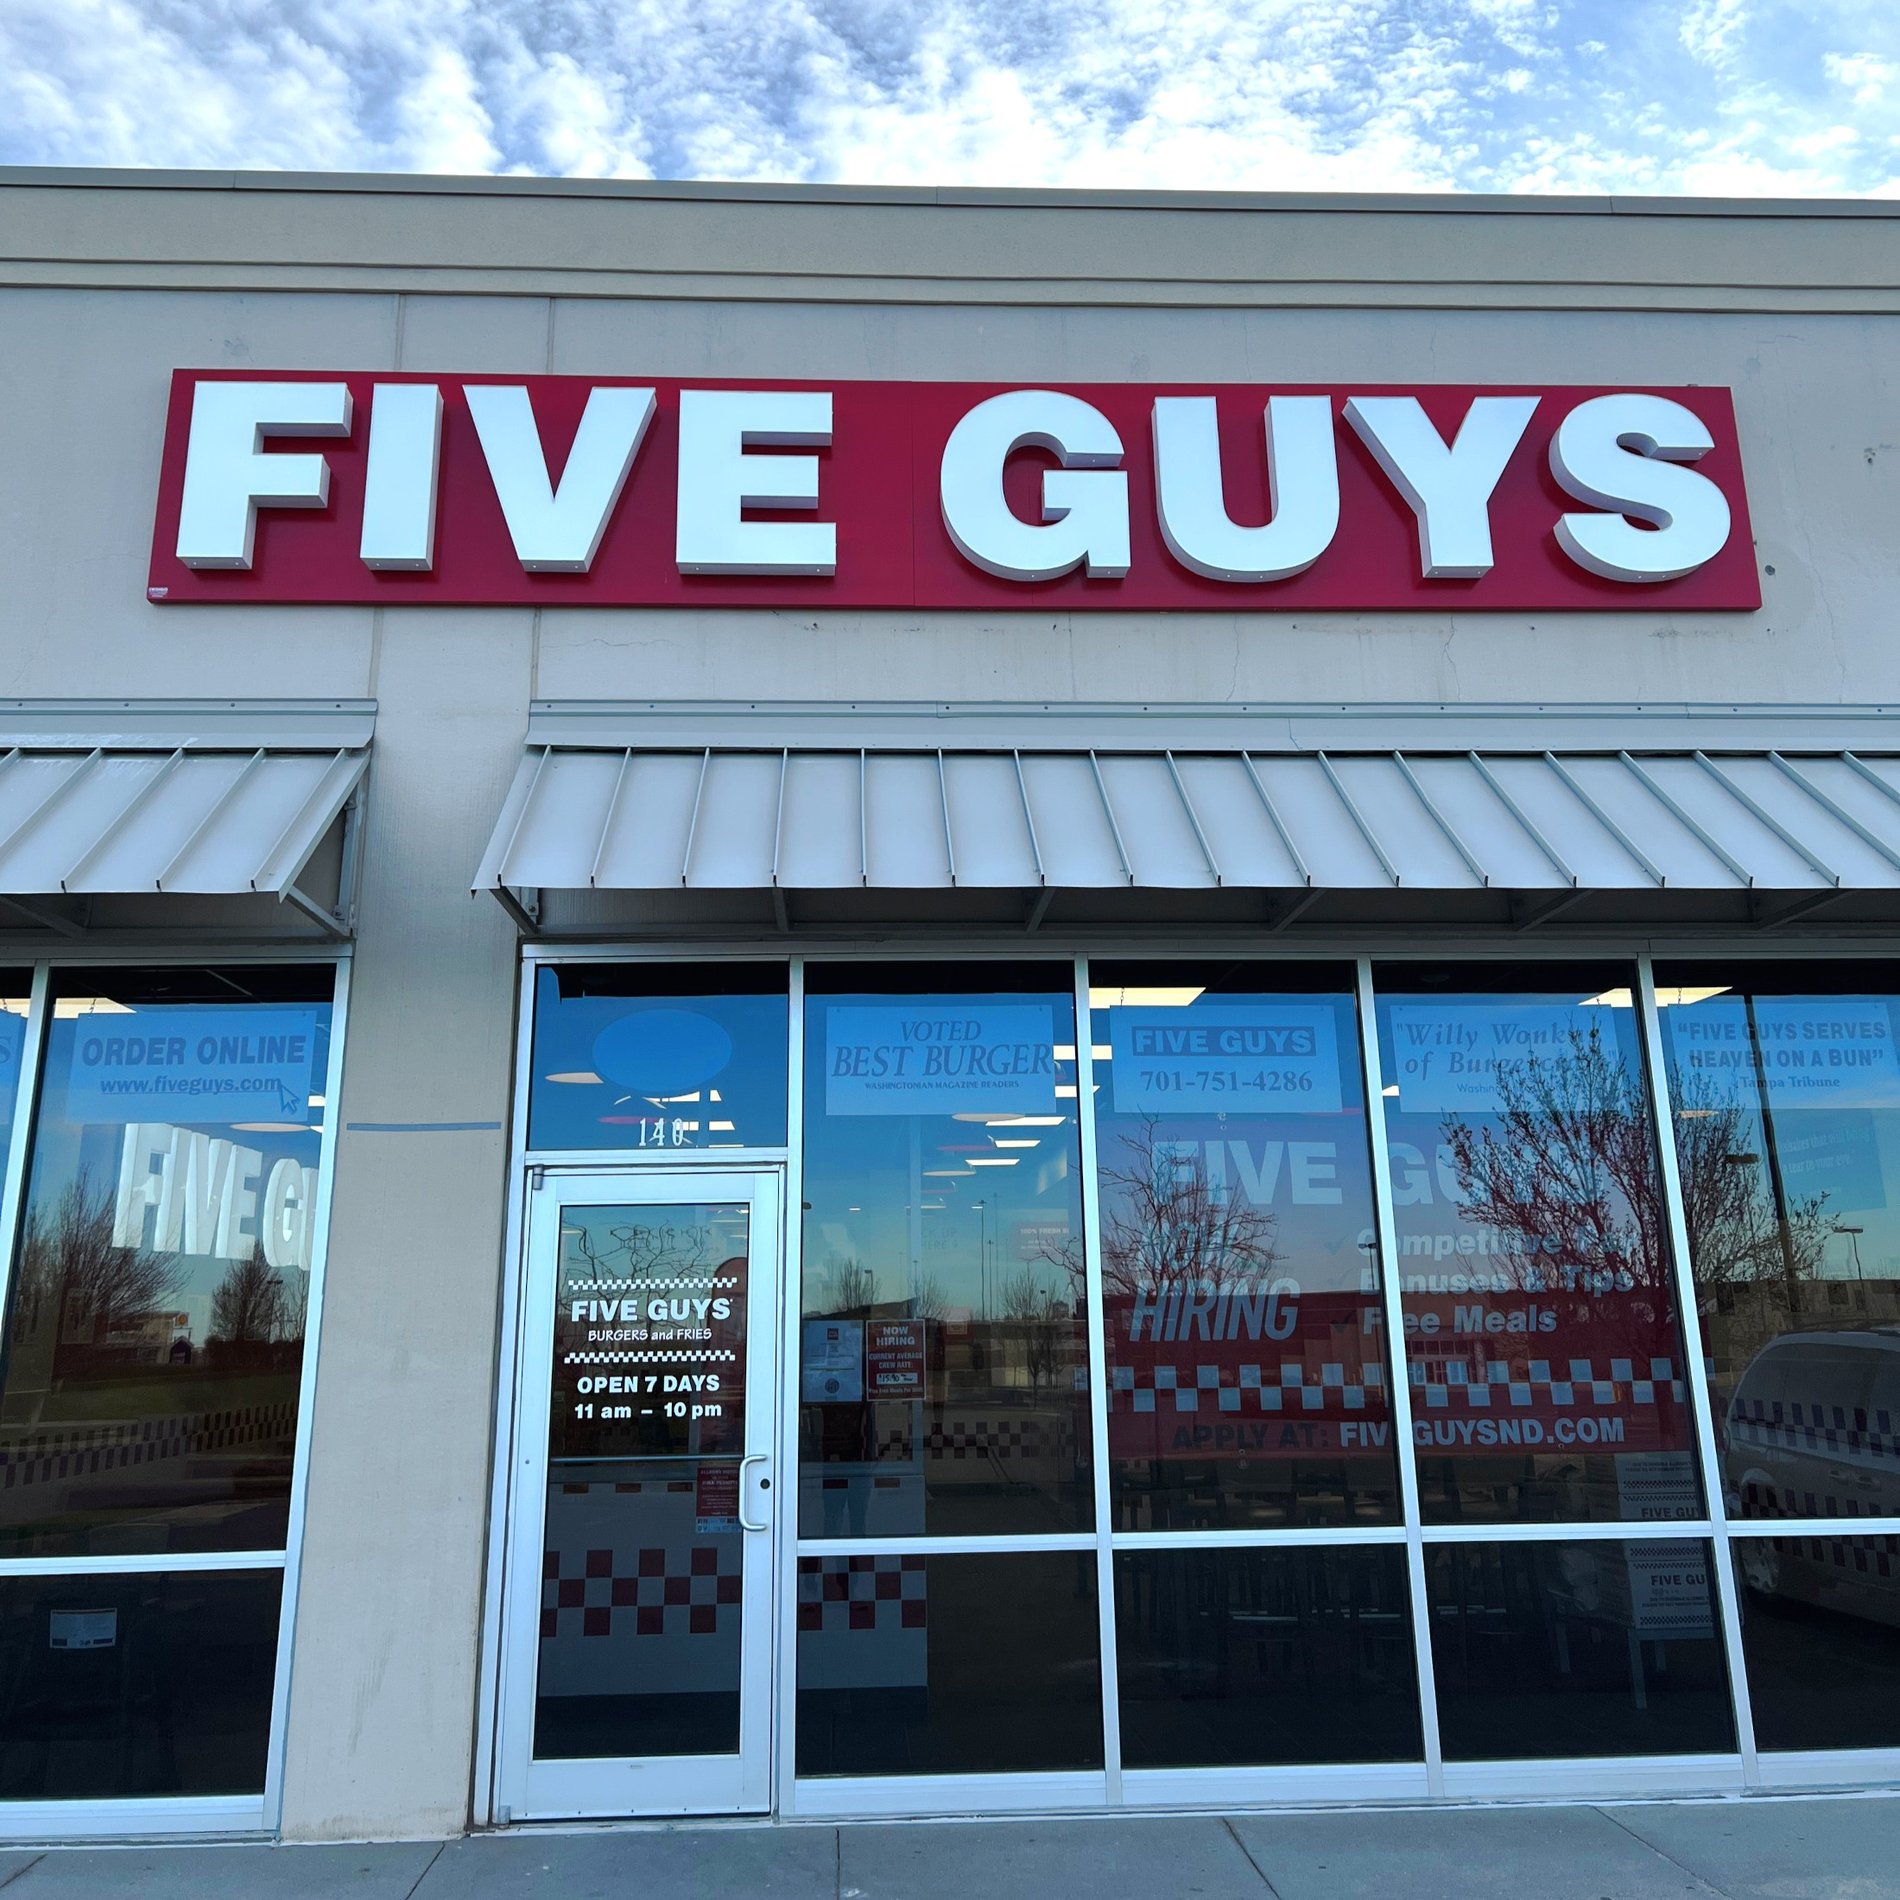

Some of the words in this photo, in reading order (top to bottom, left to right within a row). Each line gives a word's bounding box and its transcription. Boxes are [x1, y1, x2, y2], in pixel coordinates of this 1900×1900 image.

[176, 380, 837, 576] FIVE
[940, 389, 1731, 583] GUYS
[901, 1020, 982, 1042] VOTED
[1135, 1029, 1209, 1053] FIVE
[1219, 1029, 1312, 1054] GUYS
[1742, 1022, 1798, 1040] GUYS
[1802, 1021, 1887, 1039] SERVES
[81, 1036, 187, 1066] ORDER
[196, 1035, 306, 1065] ONLINE
[831, 1045, 914, 1077] BEST
[922, 1043, 1053, 1076] BURGER
[1689, 1049, 1771, 1068] HEAVEN
[1776, 1049, 1806, 1067] ON
[1810, 1049, 1829, 1067] A
[1404, 1051, 1434, 1080] of
[100, 1074, 282, 1096] www.fiveguys.com
[865, 1081, 934, 1090] WASHINGTONIAN
[935, 1080, 979, 1089] MAGAZINE
[981, 1079, 1020, 1089] READERS
[1140, 1070, 1313, 1092] 701-751-4286
[1740, 1075, 1785, 1090] Tampa
[1788, 1075, 1841, 1088] Tribune
[638, 1117, 684, 1147] 140
[1151, 1140, 1343, 1205] FIVE
[112, 1122, 263, 1261] FIVE
[1560, 1264, 1635, 1297] Tips
[571, 1299, 638, 1322] FIVE
[648, 1298, 732, 1321] GUYS
[1129, 1277, 1301, 1343] HIRING
[1363, 1306, 1441, 1335] Fee
[1454, 1304, 1558, 1334] Meals
[588, 1329, 648, 1341] BURGERS
[651, 1329, 674, 1341] and
[677, 1328, 712, 1340] FRIES
[876, 1336, 915, 1346] HIRING
[883, 1326, 909, 1335] NOW
[577, 1375, 639, 1393] OPEN
[644, 1375, 658, 1393] 7
[663, 1374, 720, 1392] DAYS
[574, 1403, 594, 1419] 11
[601, 1405, 631, 1419] am
[664, 1402, 687, 1418] 10
[692, 1404, 722, 1420] pm
[1171, 1422, 1269, 1450] APPLY
[1278, 1422, 1329, 1449] AT:
[1340, 1416, 1625, 1447] FIVGUYSND.COM
[1641, 1507, 1671, 1519] FIVE
[1651, 1575, 1684, 1586] FIVE
